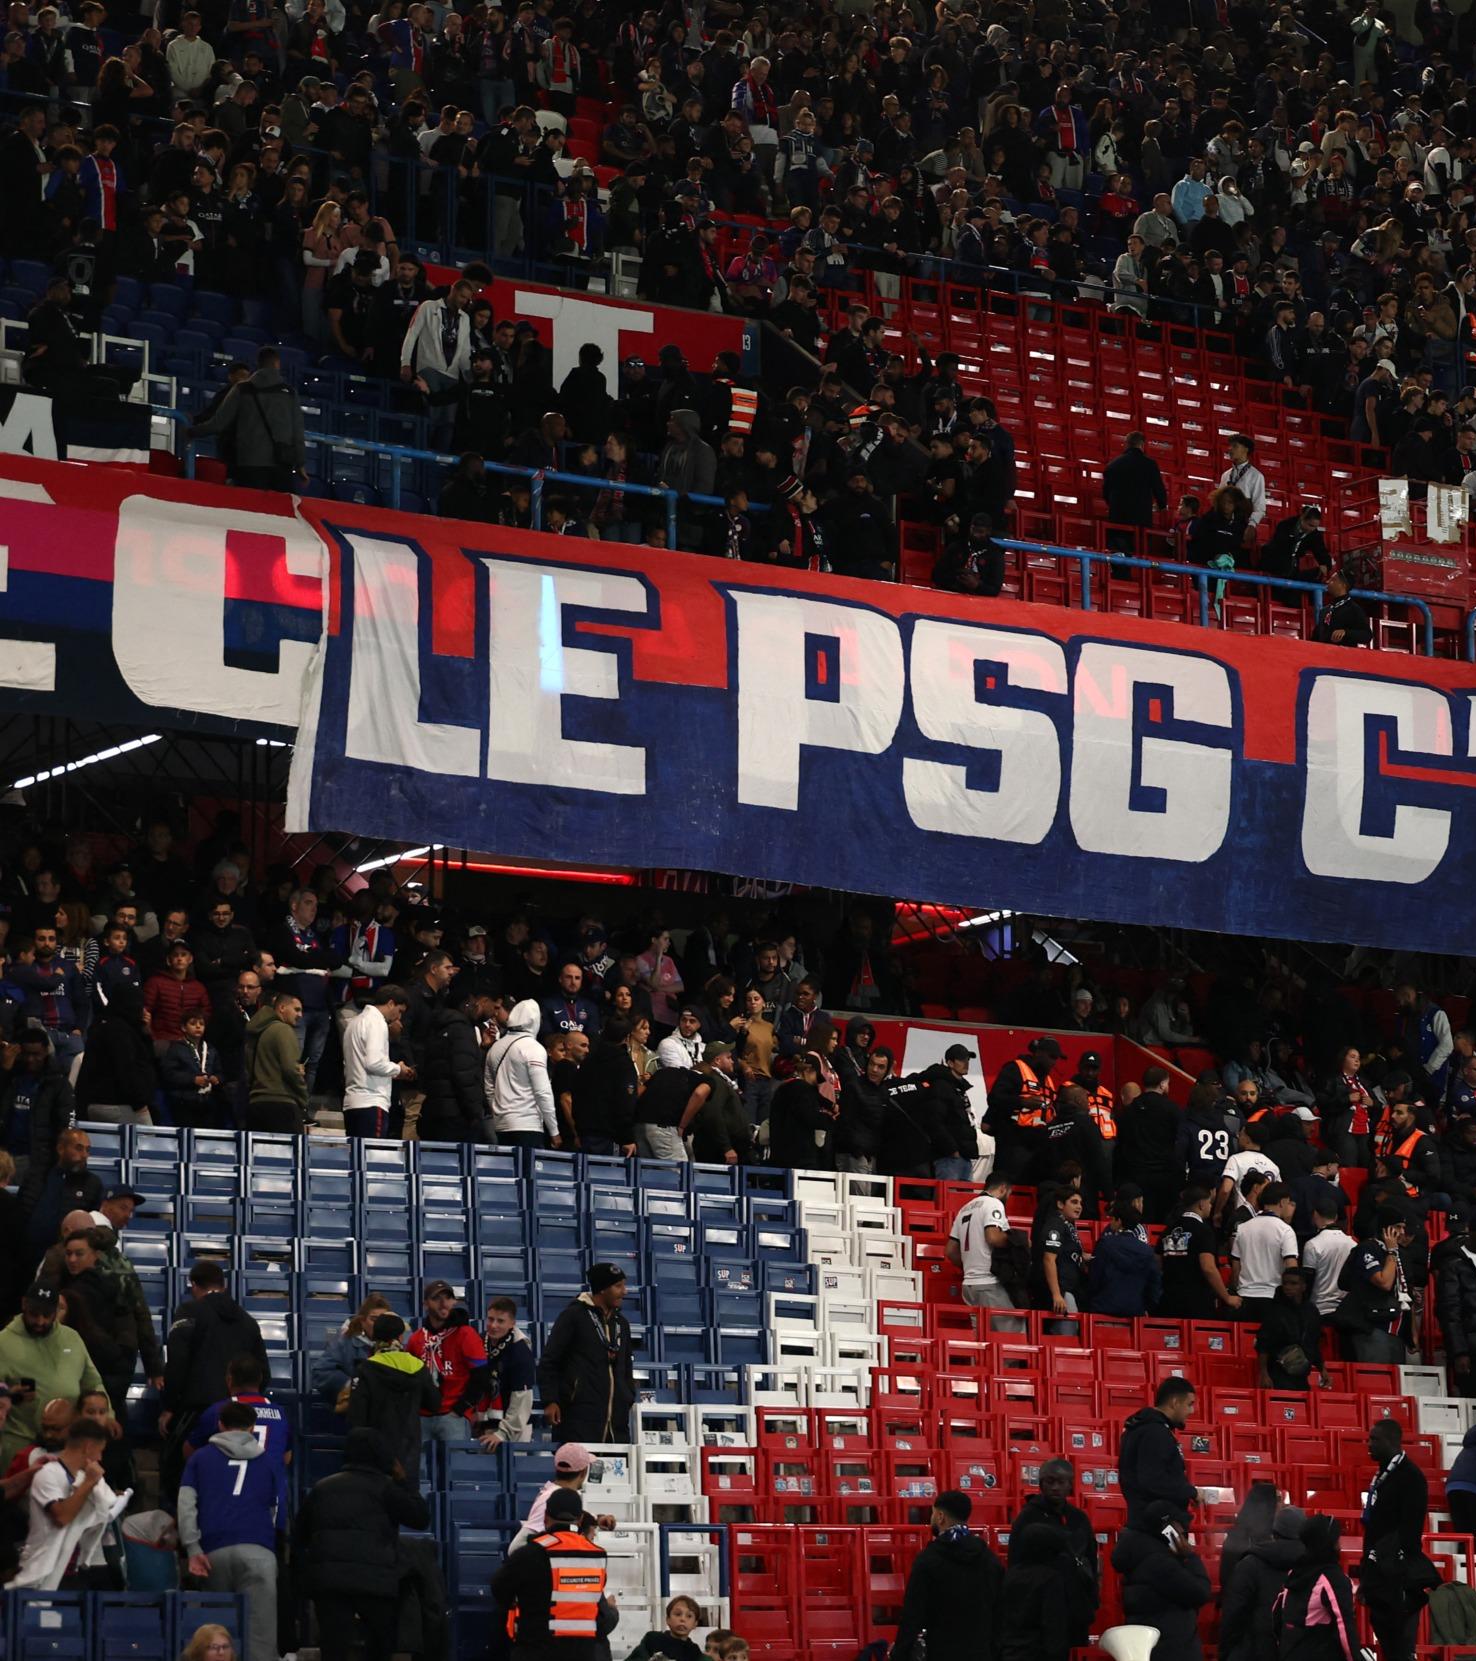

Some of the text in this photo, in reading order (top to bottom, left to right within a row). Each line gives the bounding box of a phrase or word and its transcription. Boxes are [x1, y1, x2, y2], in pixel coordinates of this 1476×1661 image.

[514, 291, 654, 400] T
[342, 528, 647, 795] LE
[727, 589, 1233, 863] PSG
[1198, 1129, 1229, 1161] 23
[717, 1269, 730, 1280] SUP
[228, 1459, 248, 1496] 7
